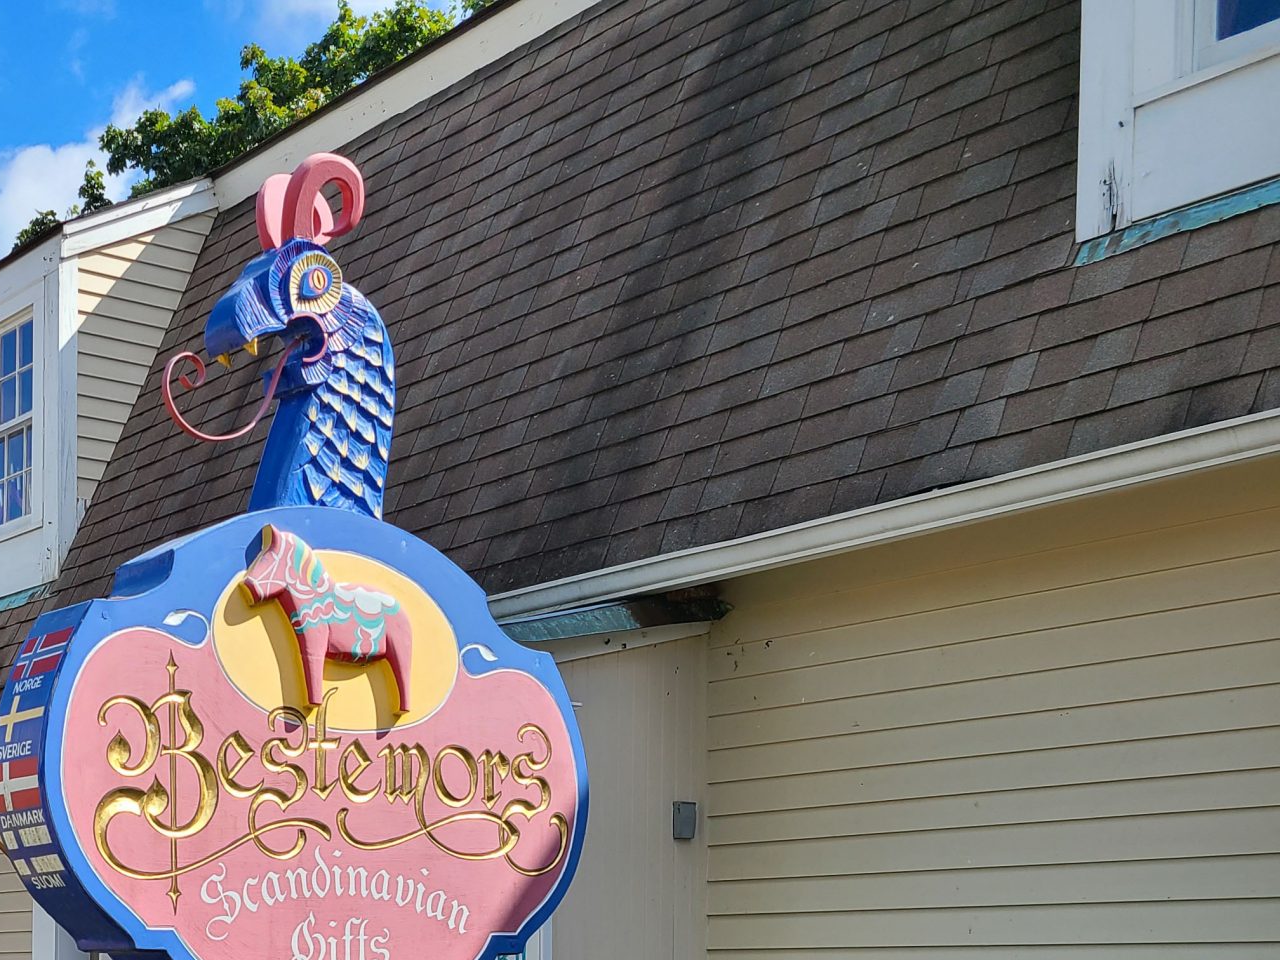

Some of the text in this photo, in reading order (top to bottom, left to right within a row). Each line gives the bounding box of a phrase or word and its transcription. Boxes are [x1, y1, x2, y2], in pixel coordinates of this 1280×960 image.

[12, 674, 44, 694] NORGE
[93, 685, 569, 880] Bestemors
[0, 808, 46, 829] DANMARK
[31, 873, 66, 890] SUOMI
[200, 845, 471, 941] Scandinavian
